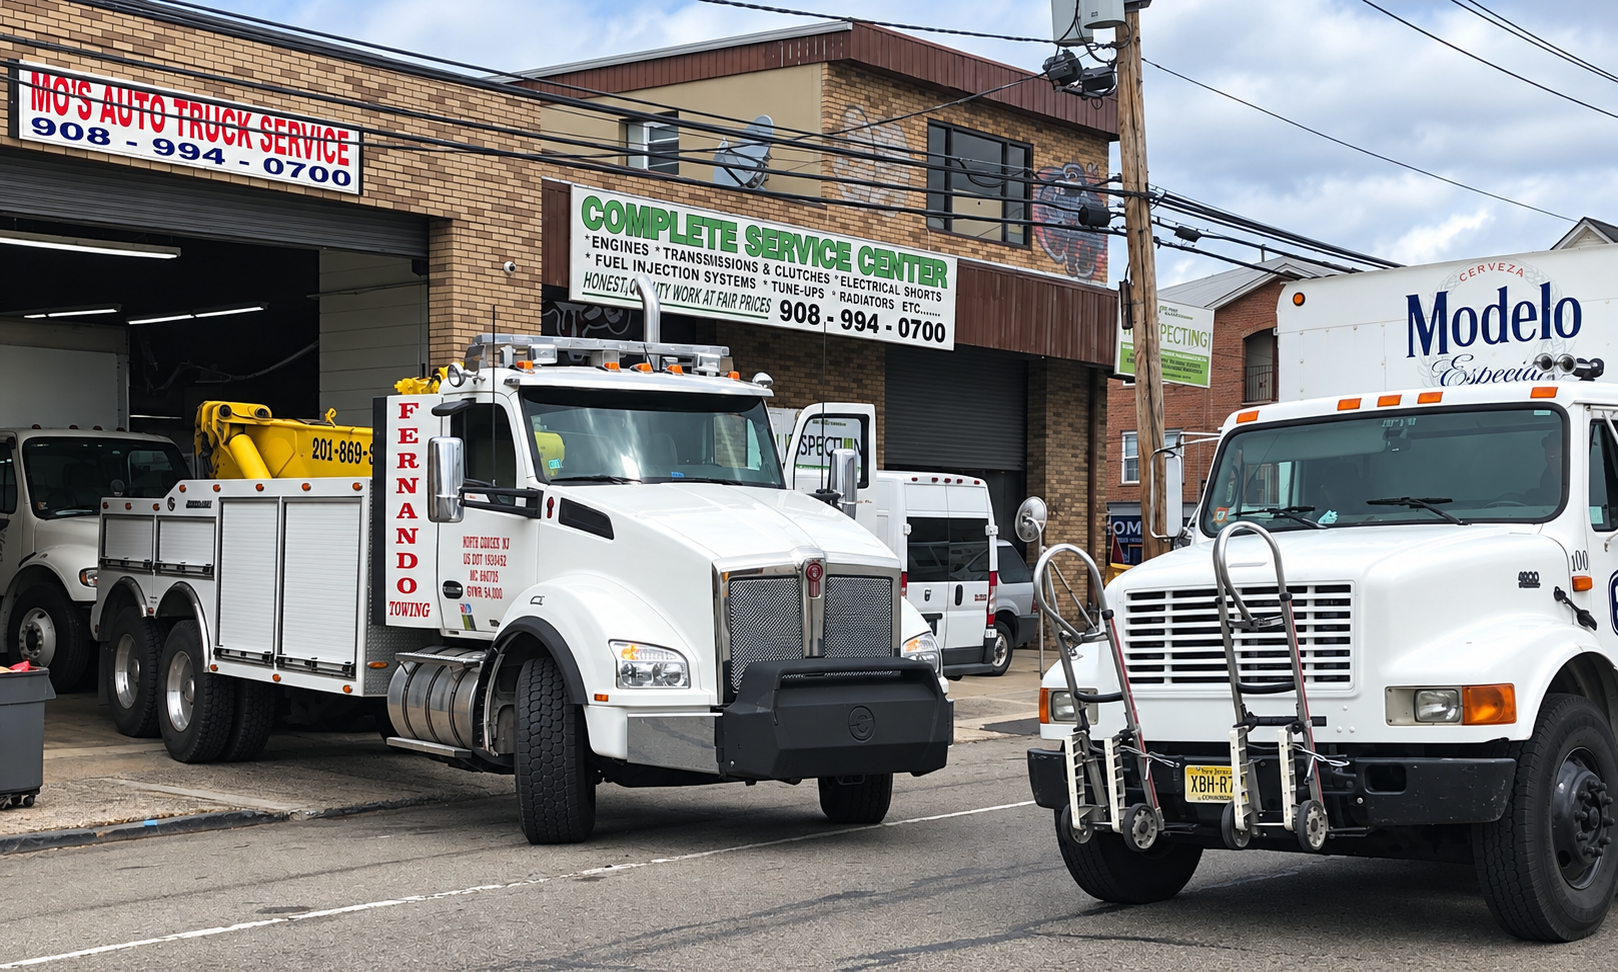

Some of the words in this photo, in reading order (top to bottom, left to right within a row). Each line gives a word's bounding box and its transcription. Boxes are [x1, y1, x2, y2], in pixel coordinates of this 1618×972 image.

[31, 70, 92, 120] MO'S
[100, 85, 165, 133] AUTO
[174, 98, 253, 149] TRUCK
[260, 115, 350, 167] SERVICE
[31, 117, 111, 146] 908
[152, 138, 226, 165] 994
[263, 157, 352, 187] 0700
[581, 195, 738, 254] COMPLETE
[744, 224, 852, 273] SERVICE
[857, 245, 948, 290] CENTER
[595, 253, 629, 271] FUEL
[633, 258, 700, 281] INJECTION
[704, 270, 756, 290] SYSTEMS
[772, 280, 825, 299] TUNE-UPS
[839, 291, 895, 310] RADIATORS
[763, 263, 771, 276] &
[775, 264, 830, 284] CLUTCHES
[904, 286, 942, 302] SHORTS
[1459, 262, 1524, 282] CERVEZA
[673, 284, 702, 304] WORK
[702, 289, 716, 306] AT
[716, 291, 738, 309] FAIR
[739, 294, 772, 314] PRICES
[779, 299, 821, 326] 908
[840, 308, 880, 334] 994
[898, 317, 946, 343] 0700
[1406, 281, 1582, 359] Modelo
[1432, 353, 1546, 387] Especia
[396, 402, 420, 595] FERNANDO
[1571, 549, 1589, 572] 100
[389, 601, 431, 618] TOWING
